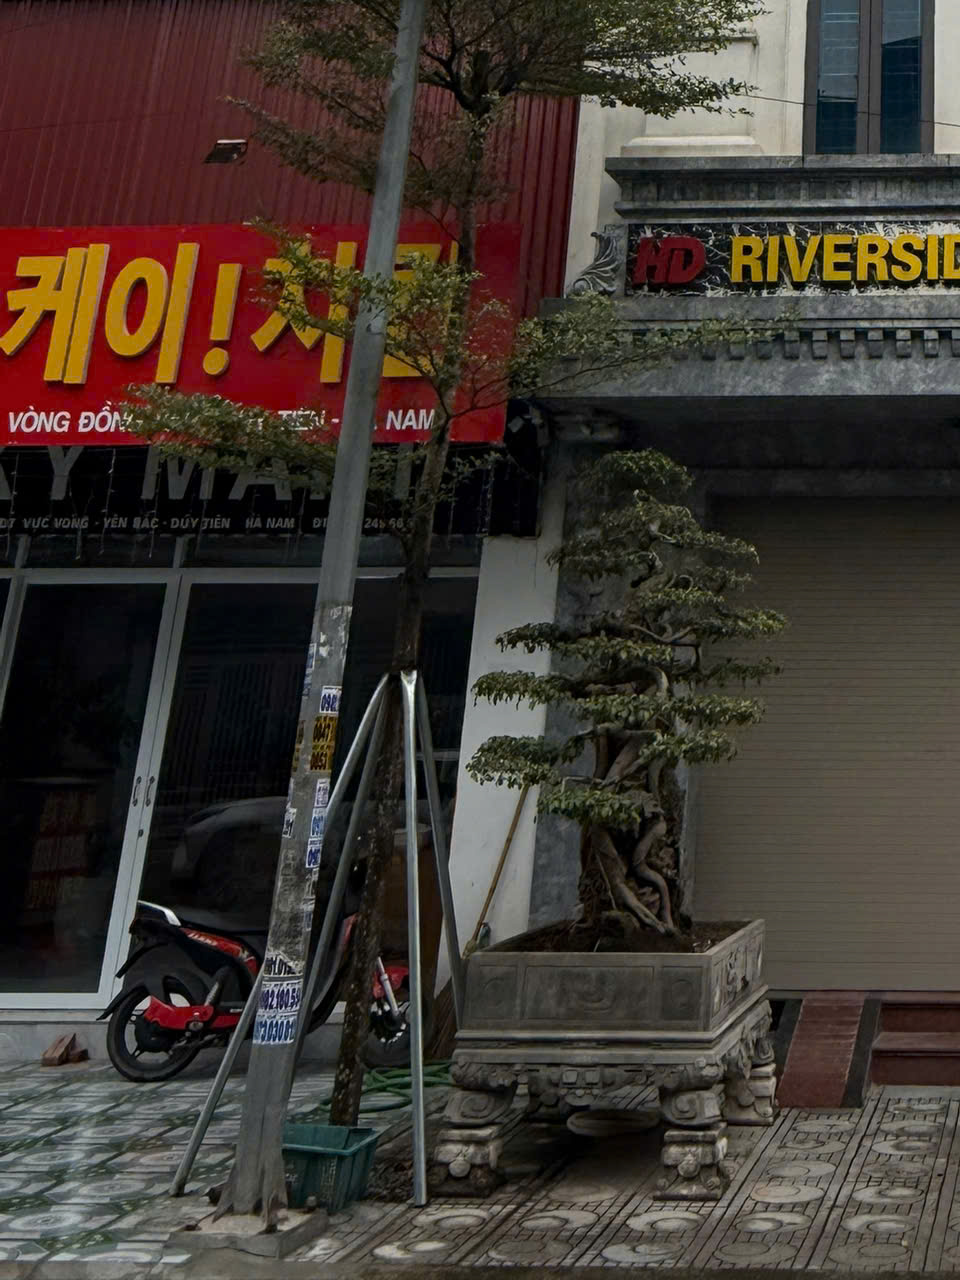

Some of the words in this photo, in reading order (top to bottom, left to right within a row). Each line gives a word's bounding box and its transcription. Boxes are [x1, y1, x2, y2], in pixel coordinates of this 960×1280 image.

[632, 235, 706, 285] HD
[8, 405, 71, 433] VÒNG
[78, 401, 143, 433] ĐỒN
[386, 409, 437, 431] NAM
[266, 517, 296, 529] NAM
